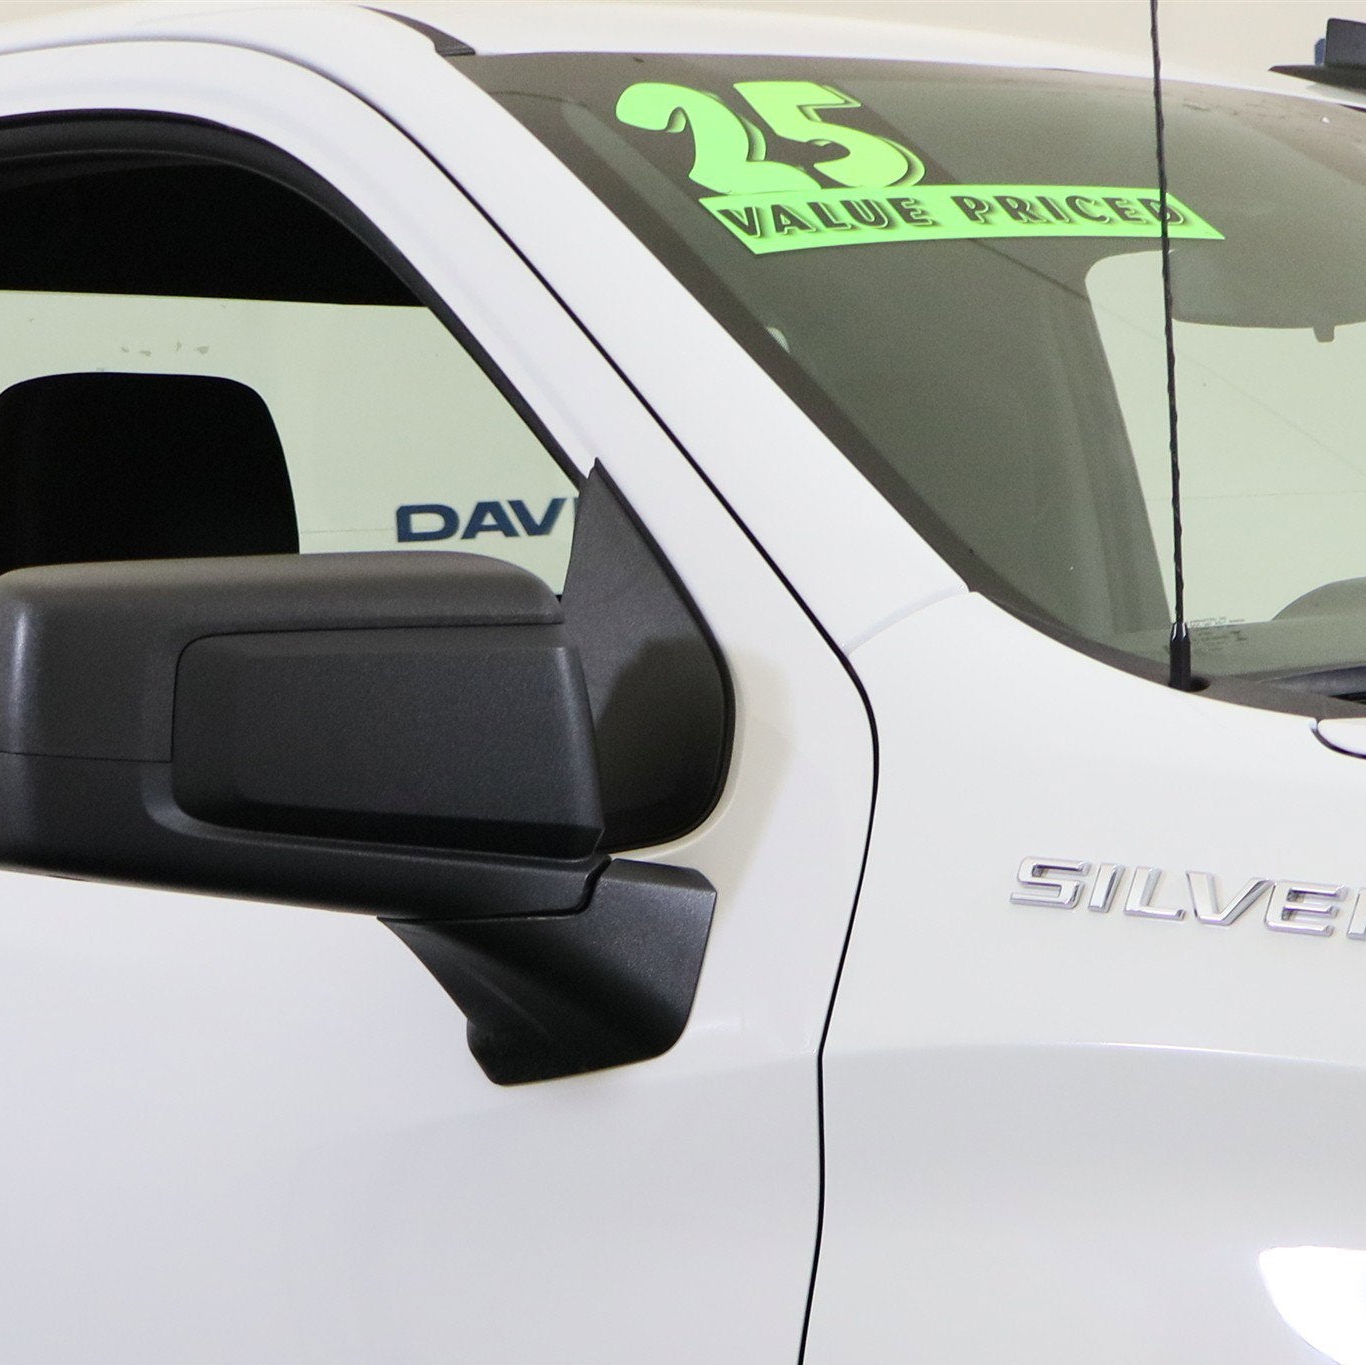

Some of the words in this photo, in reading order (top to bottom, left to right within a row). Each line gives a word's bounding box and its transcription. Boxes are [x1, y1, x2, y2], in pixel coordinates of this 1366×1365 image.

[616, 81, 925, 195] 25
[717, 197, 933, 238] VALUE
[950, 195, 1187, 225] PRICED
[396, 497, 579, 543] DAV
